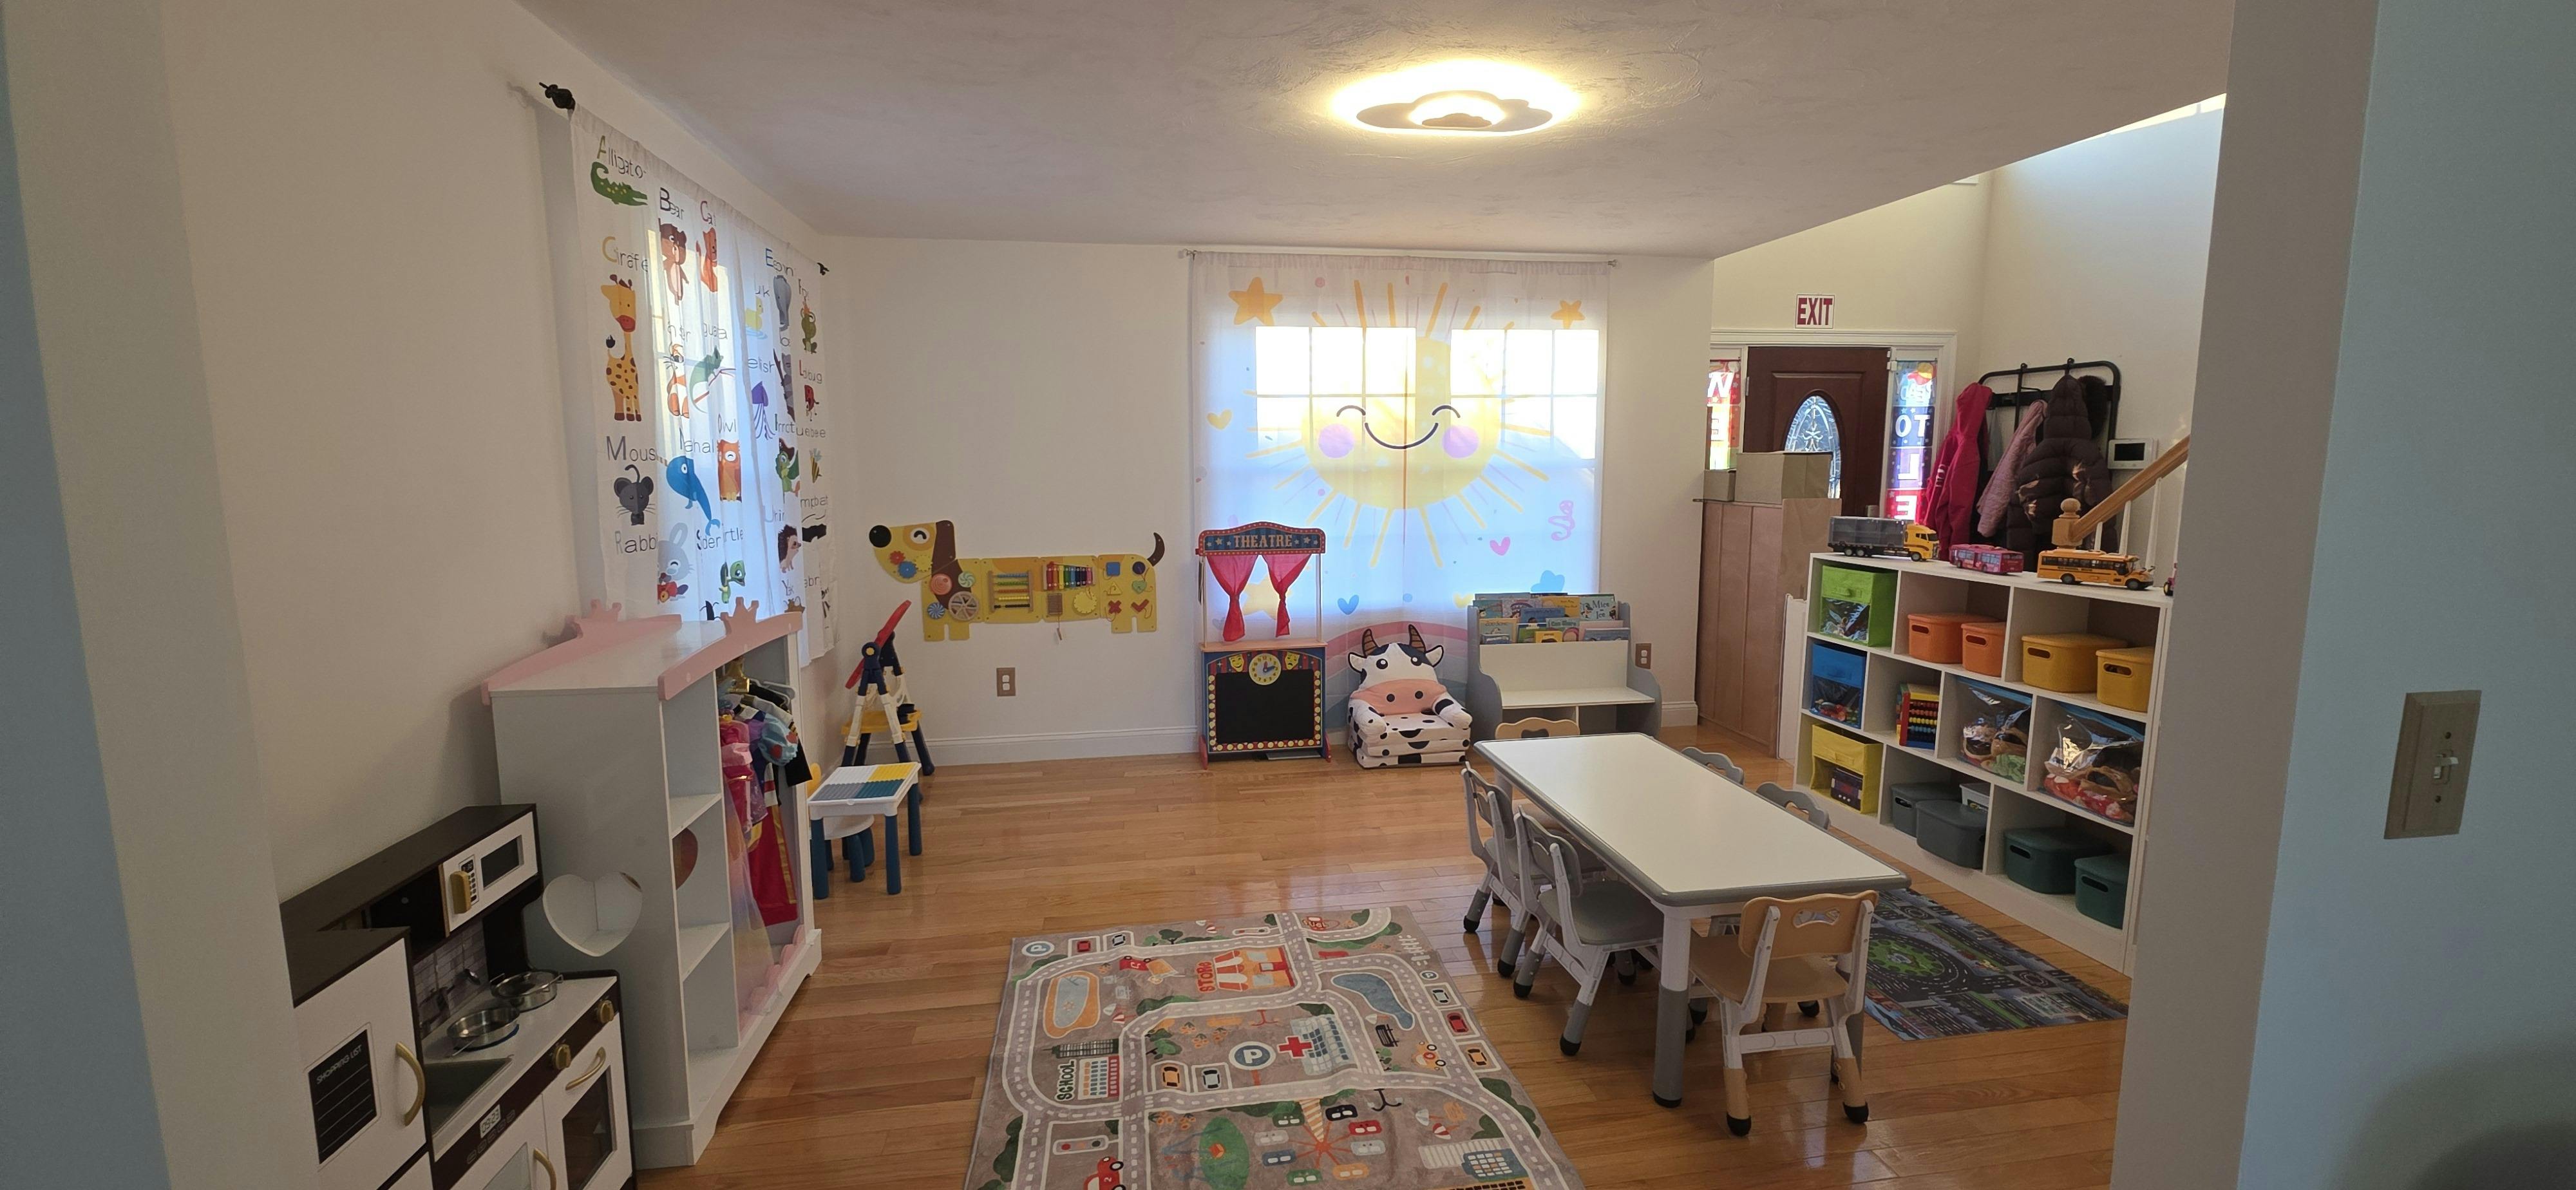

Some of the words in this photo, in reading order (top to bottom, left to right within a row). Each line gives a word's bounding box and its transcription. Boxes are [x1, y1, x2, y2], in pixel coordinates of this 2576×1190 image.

[1797, 298, 1833, 325] EXIT
[606, 436, 658, 461] Mous
[1233, 534, 1293, 548] THEATRE
[1592, 600, 1610, 609] Mice
[316, 1055, 350, 1085] SHOPPING
[350, 1044, 362, 1059] LIST
[1243, 1048, 1263, 1064] P
[1056, 1061, 1075, 1100] SCHOOL
